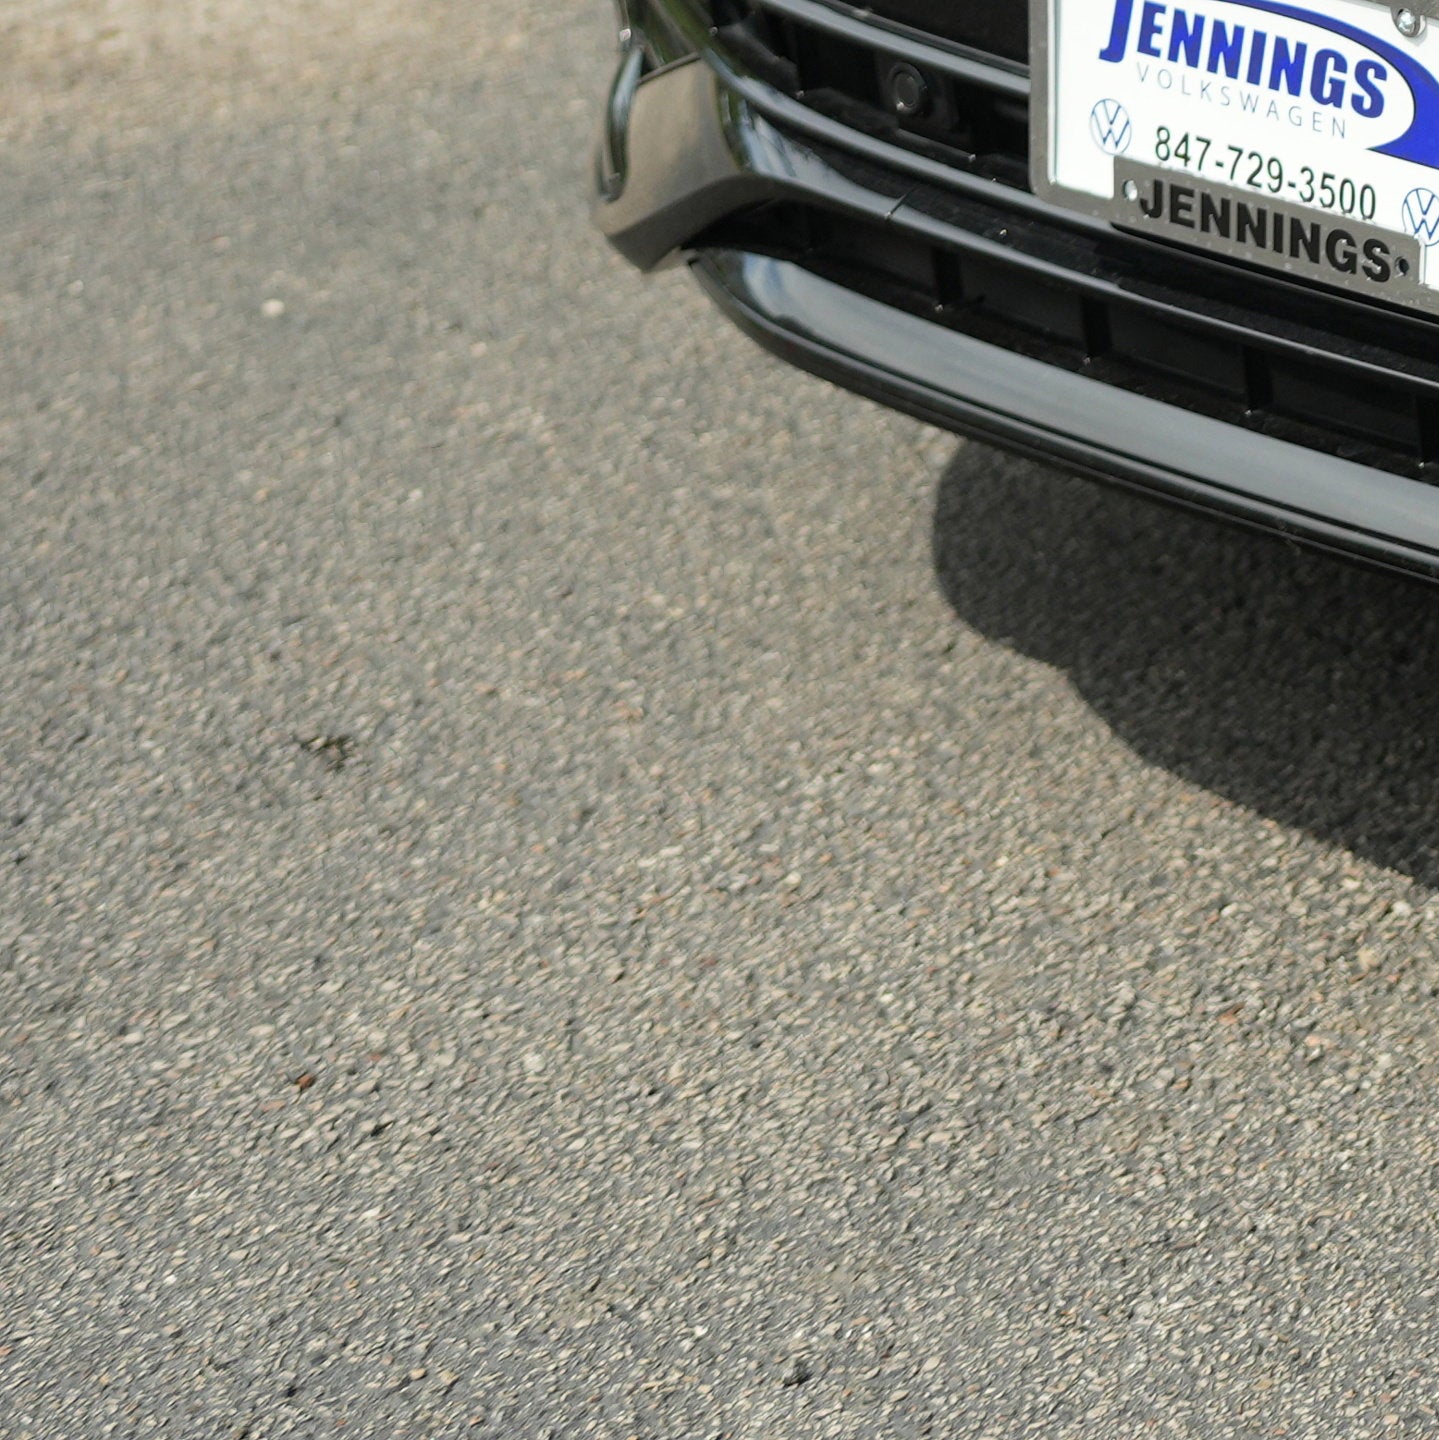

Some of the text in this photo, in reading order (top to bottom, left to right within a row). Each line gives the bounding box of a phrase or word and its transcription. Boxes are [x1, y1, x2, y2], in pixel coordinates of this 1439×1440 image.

[1136, 61, 1347, 139] VOLKSWAGEN
[1155, 125, 1377, 221] 847-729-3500
[1140, 178, 1392, 283] JENNINGS
